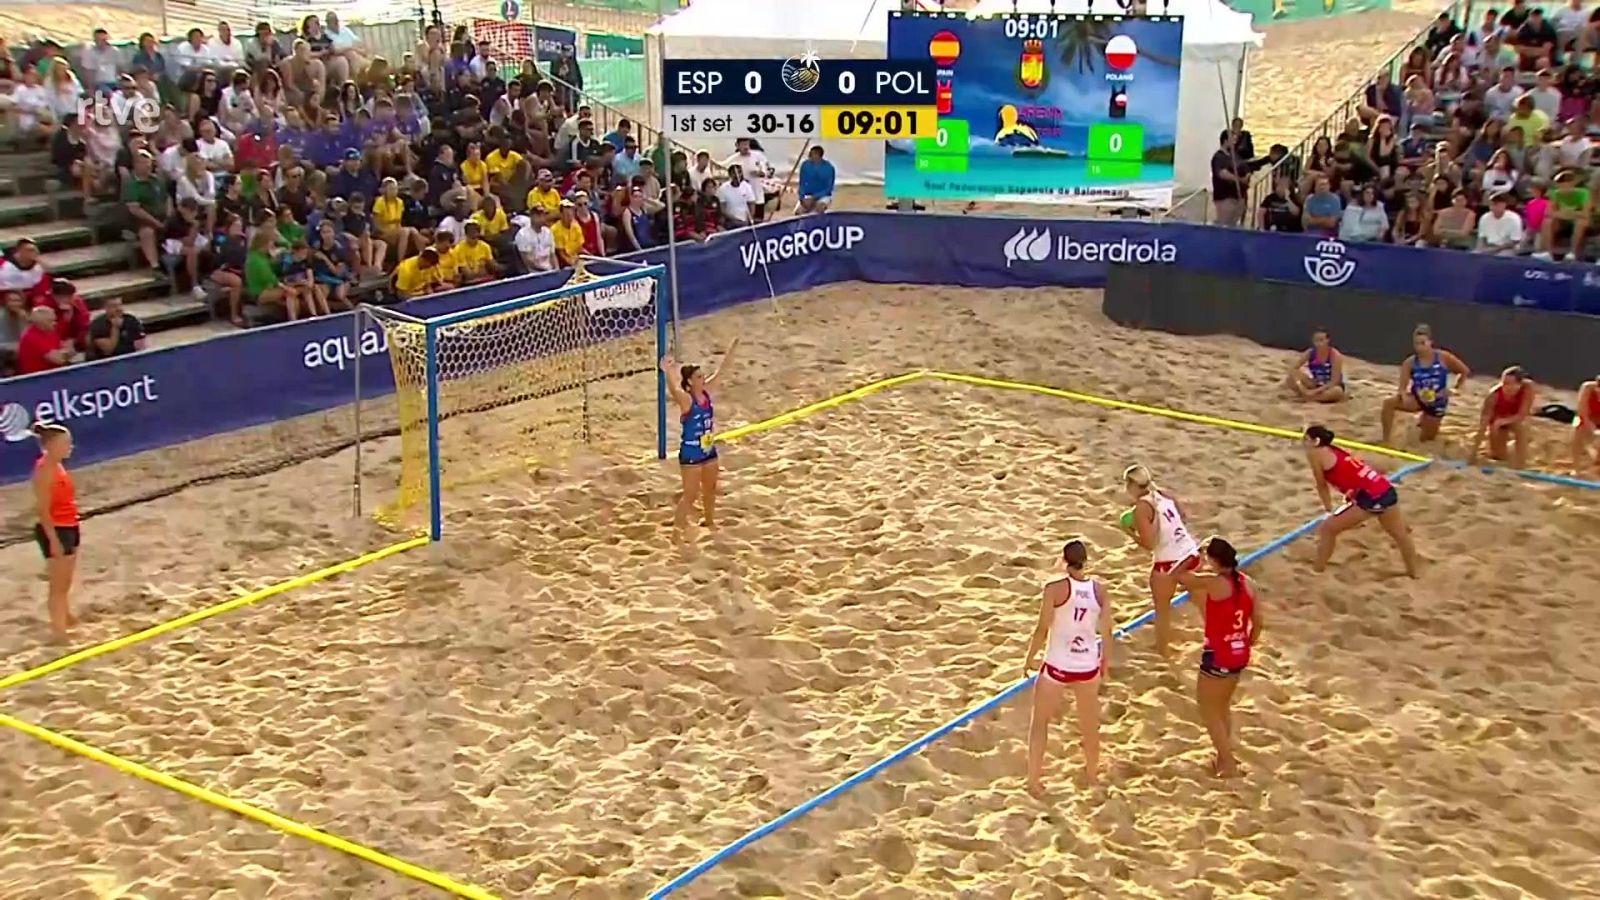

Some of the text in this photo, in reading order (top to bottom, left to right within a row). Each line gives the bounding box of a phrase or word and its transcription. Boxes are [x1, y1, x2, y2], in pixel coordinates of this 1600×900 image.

[1004, 18, 1059, 39] 09:01
[936, 69, 954, 77] PAIN
[936, 128, 948, 147] 0
[1109, 133, 1123, 153] 0
[740, 225, 864, 275] VARGROUP
[1057, 235, 1177, 262] Iberdrola
[35, 374, 159, 424] elksport
[1073, 606, 1088, 622] 17
[1232, 609, 1244, 630] 3
